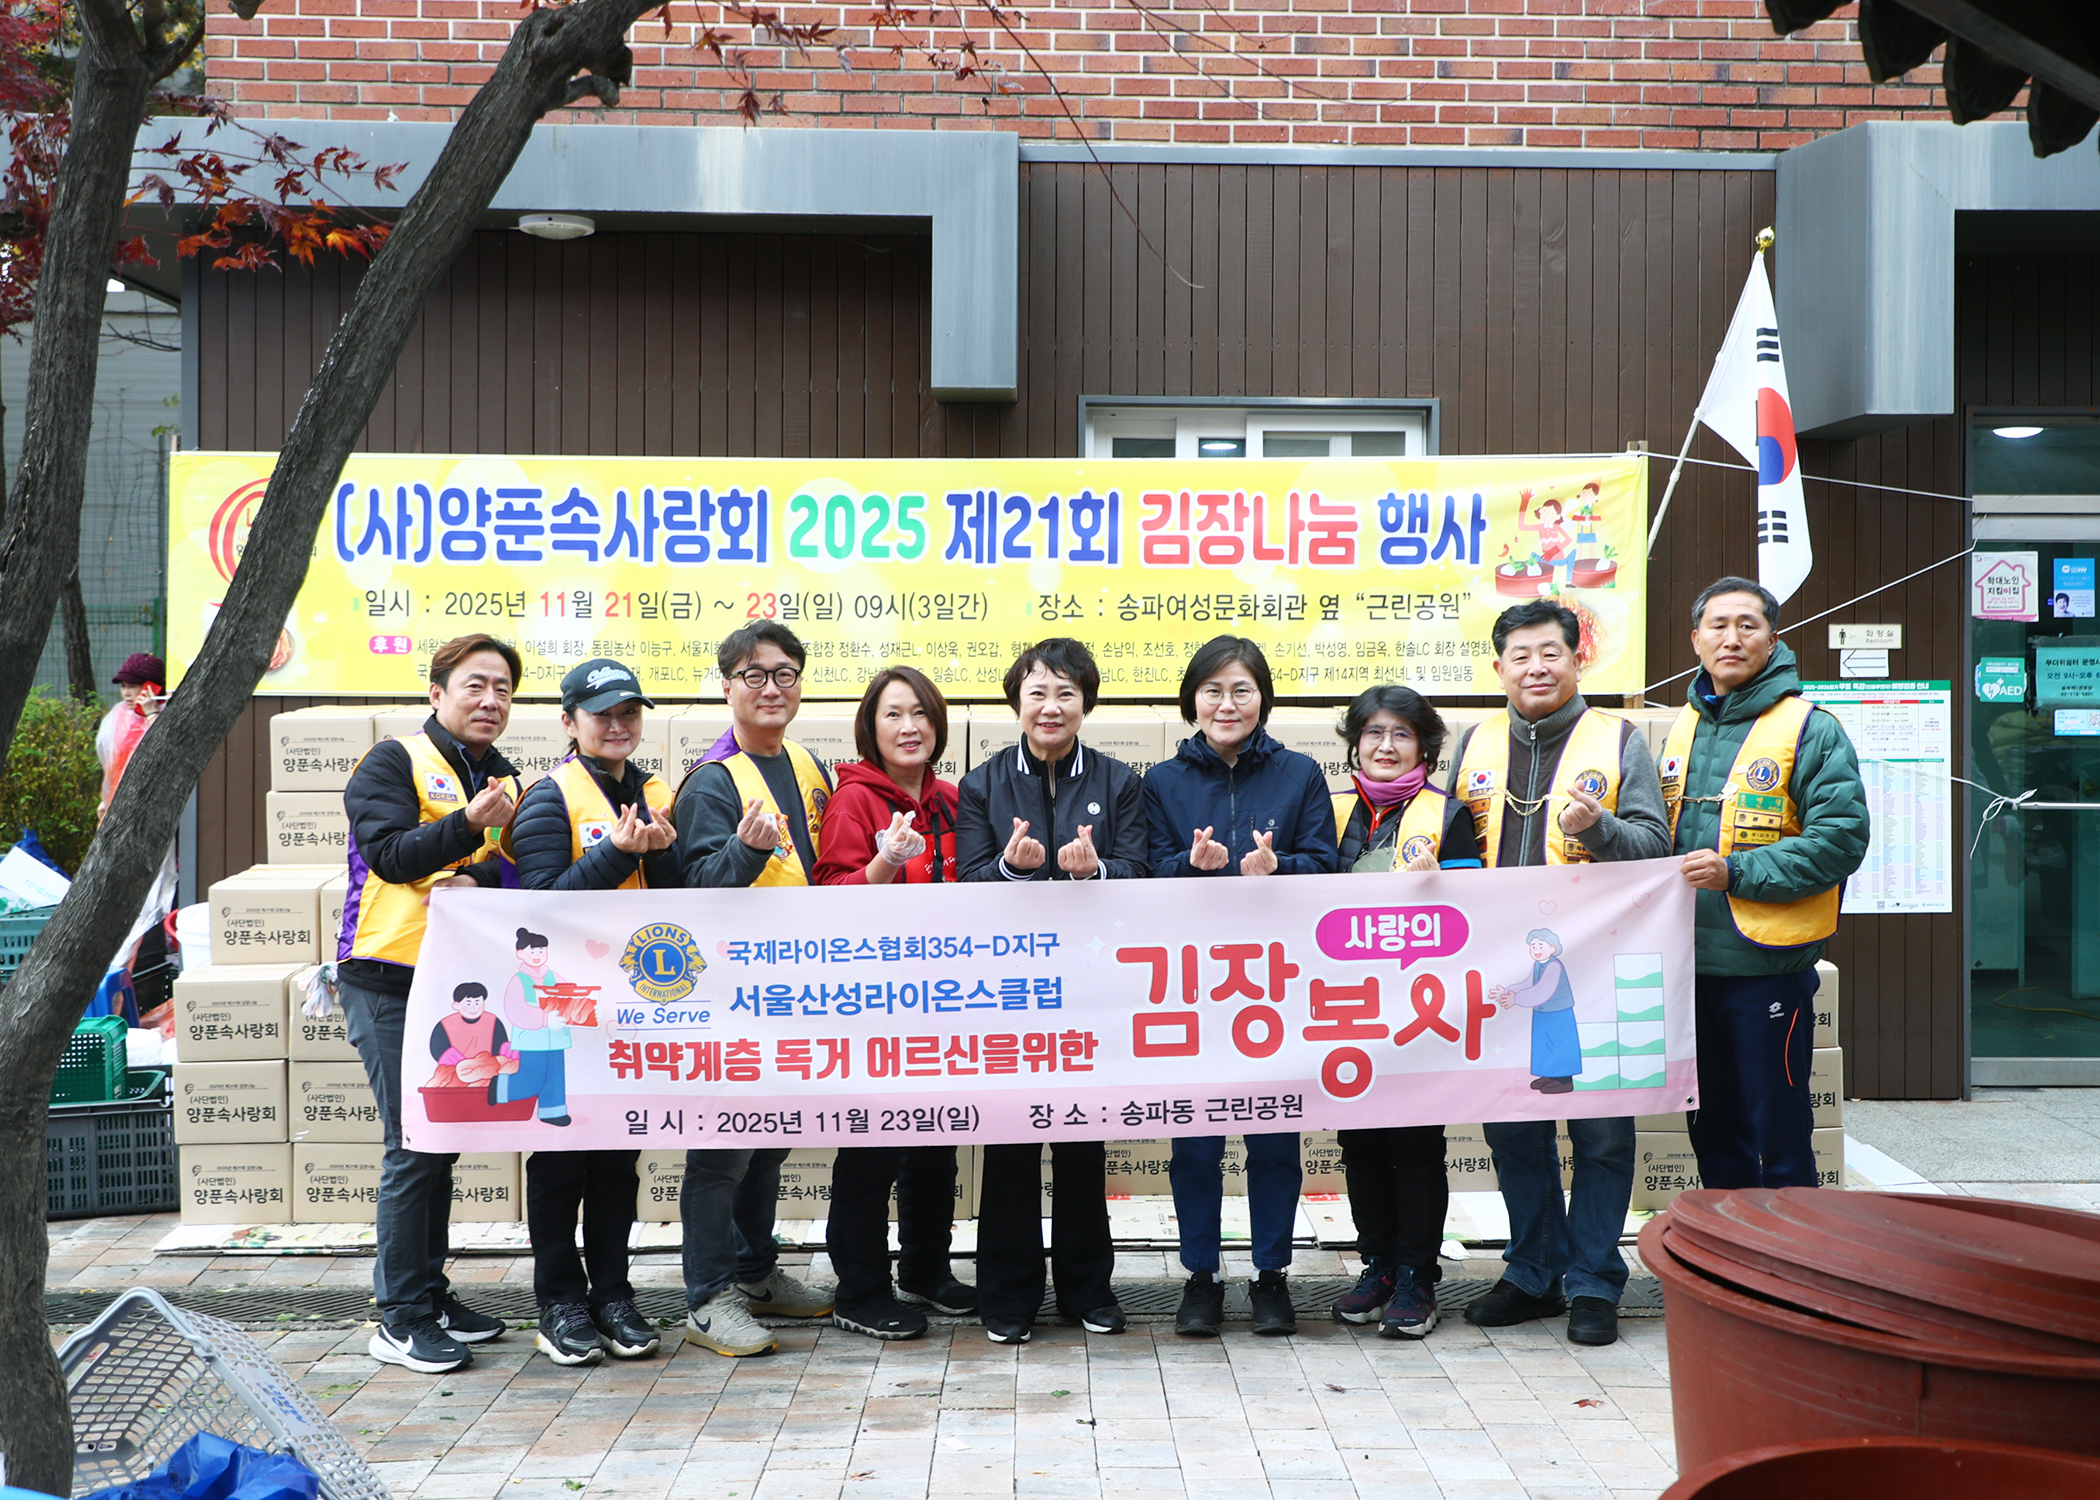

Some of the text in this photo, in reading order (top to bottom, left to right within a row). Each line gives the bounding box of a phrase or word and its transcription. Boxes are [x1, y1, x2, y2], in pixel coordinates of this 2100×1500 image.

[337, 483, 1487, 564] (사)양푼속사랑회 2025 제21회 김장나눔 행사
[365, 590, 410, 617] 일시
[445, 591, 526, 618] 2025년
[540, 590, 592, 619] 11월
[605, 590, 702, 621] 21일(금)
[746, 591, 842, 621] 23일(일)
[854, 592, 988, 621] 09시(3일간)
[1038, 593, 1085, 621] 장소
[1117, 593, 1307, 621] 송파여성문화회관
[1320, 594, 1339, 620] 옆
[591, 640, 635, 656] 동림농산
[1434, 640, 1456, 657] 회장
[1324, 665, 1369, 682] 제14지역
[1416, 666, 1426, 682] 및
[1431, 665, 1474, 682] 임원일동
[1999, 685, 2023, 696] AED
[430, 793, 456, 801] KOREA
[278, 832, 350, 847] 양푼속사랑
[223, 930, 311, 946] 양푼속사랑회
[636, 926, 687, 944] LIONS
[1344, 911, 1442, 952] 사랑의
[727, 932, 1060, 966] 국제라이온스협회354-D지구
[652, 949, 677, 975] L
[639, 983, 689, 998] INTERNATIONAL
[729, 976, 1062, 1018] 서울산성라이온스클럽
[617, 1007, 711, 1024] We Serve
[189, 1022, 279, 1041] 양푼속사랑회
[302, 1024, 347, 1041] 양푼속
[608, 1029, 1099, 1083] 취약계층 독거 어르신을위한
[186, 1105, 277, 1124] 양푼속사랑회
[303, 1104, 382, 1122] 양푼속사랑
[717, 1106, 803, 1135] 2025년
[816, 1106, 870, 1134] 11월
[881, 1104, 980, 1133] 23일(일)
[1120, 1098, 1195, 1127] 송파동
[1205, 1093, 1304, 1122] 근린공원
[1306, 1159, 1347, 1175] 양푼속
[1644, 1175, 1700, 1191] 양푼속사
[194, 1187, 284, 1205] 양푼속사랑회
[306, 1186, 379, 1203] 양푼속사랑
[451, 1186, 509, 1203] 속사랑회
